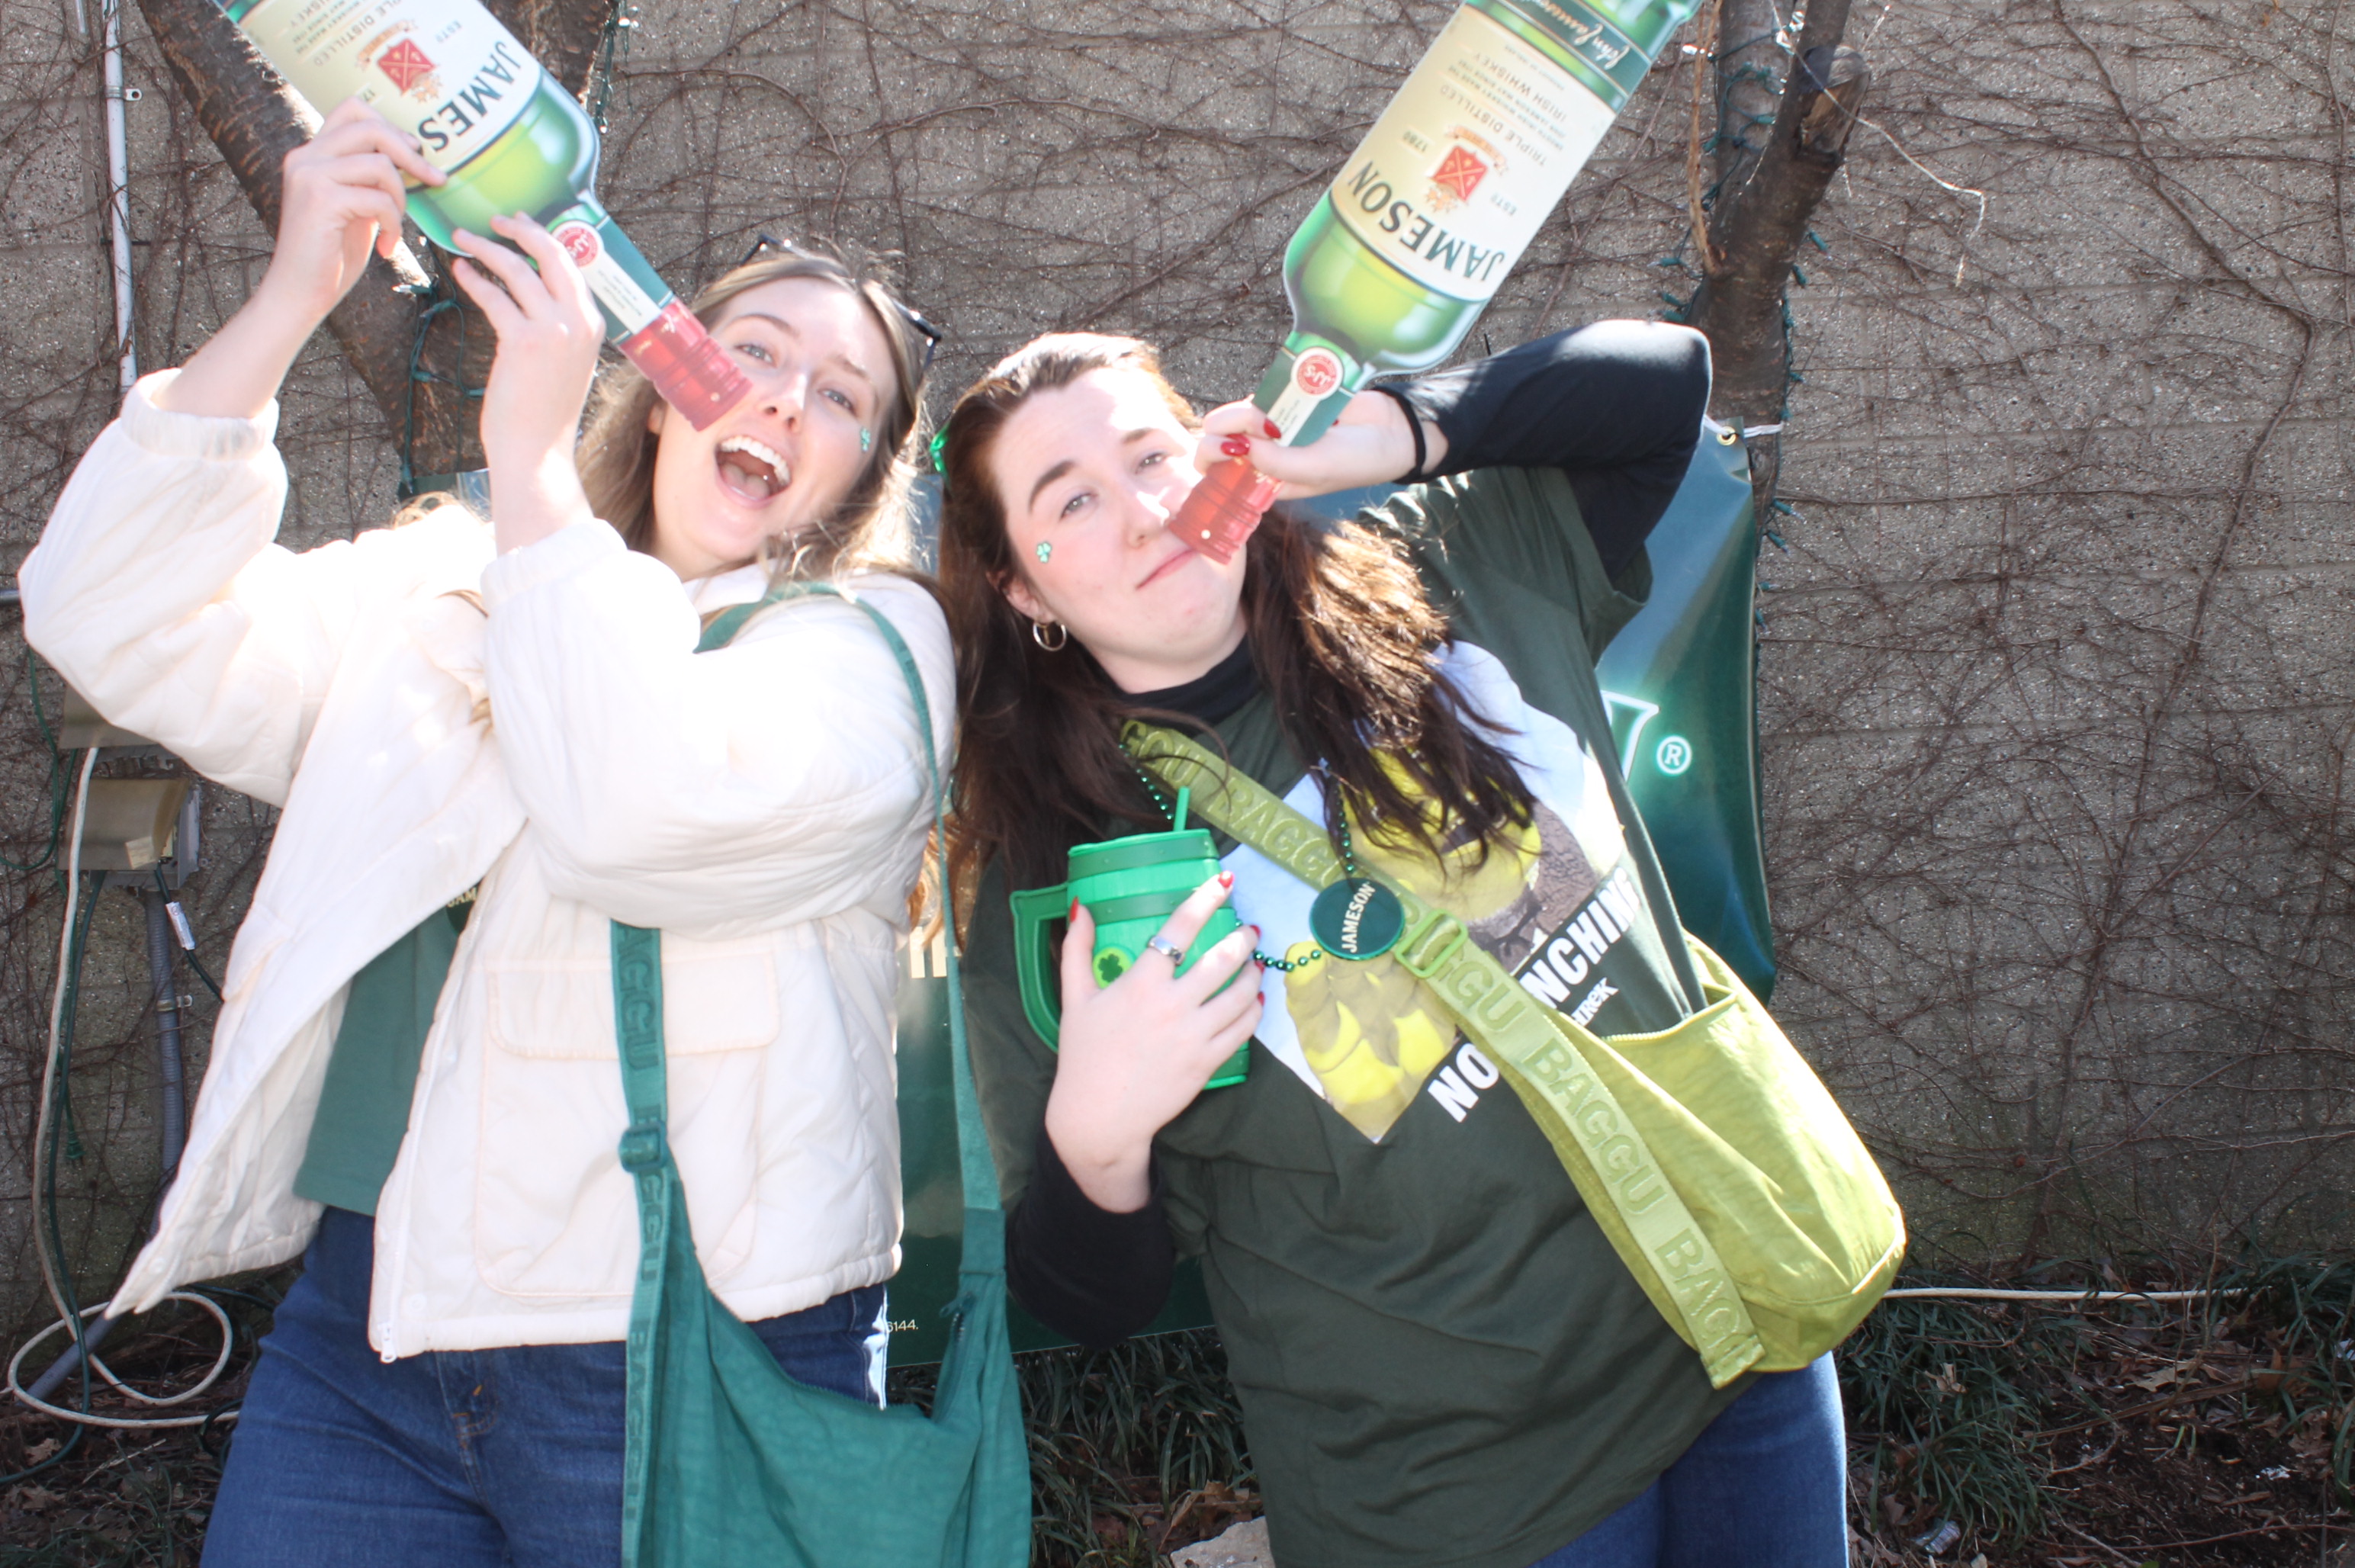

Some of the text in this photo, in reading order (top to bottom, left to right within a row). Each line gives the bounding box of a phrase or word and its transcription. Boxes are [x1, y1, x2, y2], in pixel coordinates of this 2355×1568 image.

[311, 13, 375, 68] DISTILLED
[359, 86, 375, 101] 17
[407, 42, 521, 155] JAMES
[1438, 82, 1504, 133] DISTILLED
[1472, 50, 1567, 122] IRISH WHISKEY
[1503, 128, 1548, 166] TRIPLE
[1346, 158, 1505, 281] JAMESON
[1341, 882, 1376, 953] JAMESON
[1119, 718, 1207, 793] GGU
[1527, 1038, 1668, 1214] BAGGU
[1425, 1042, 1496, 1123] NO
